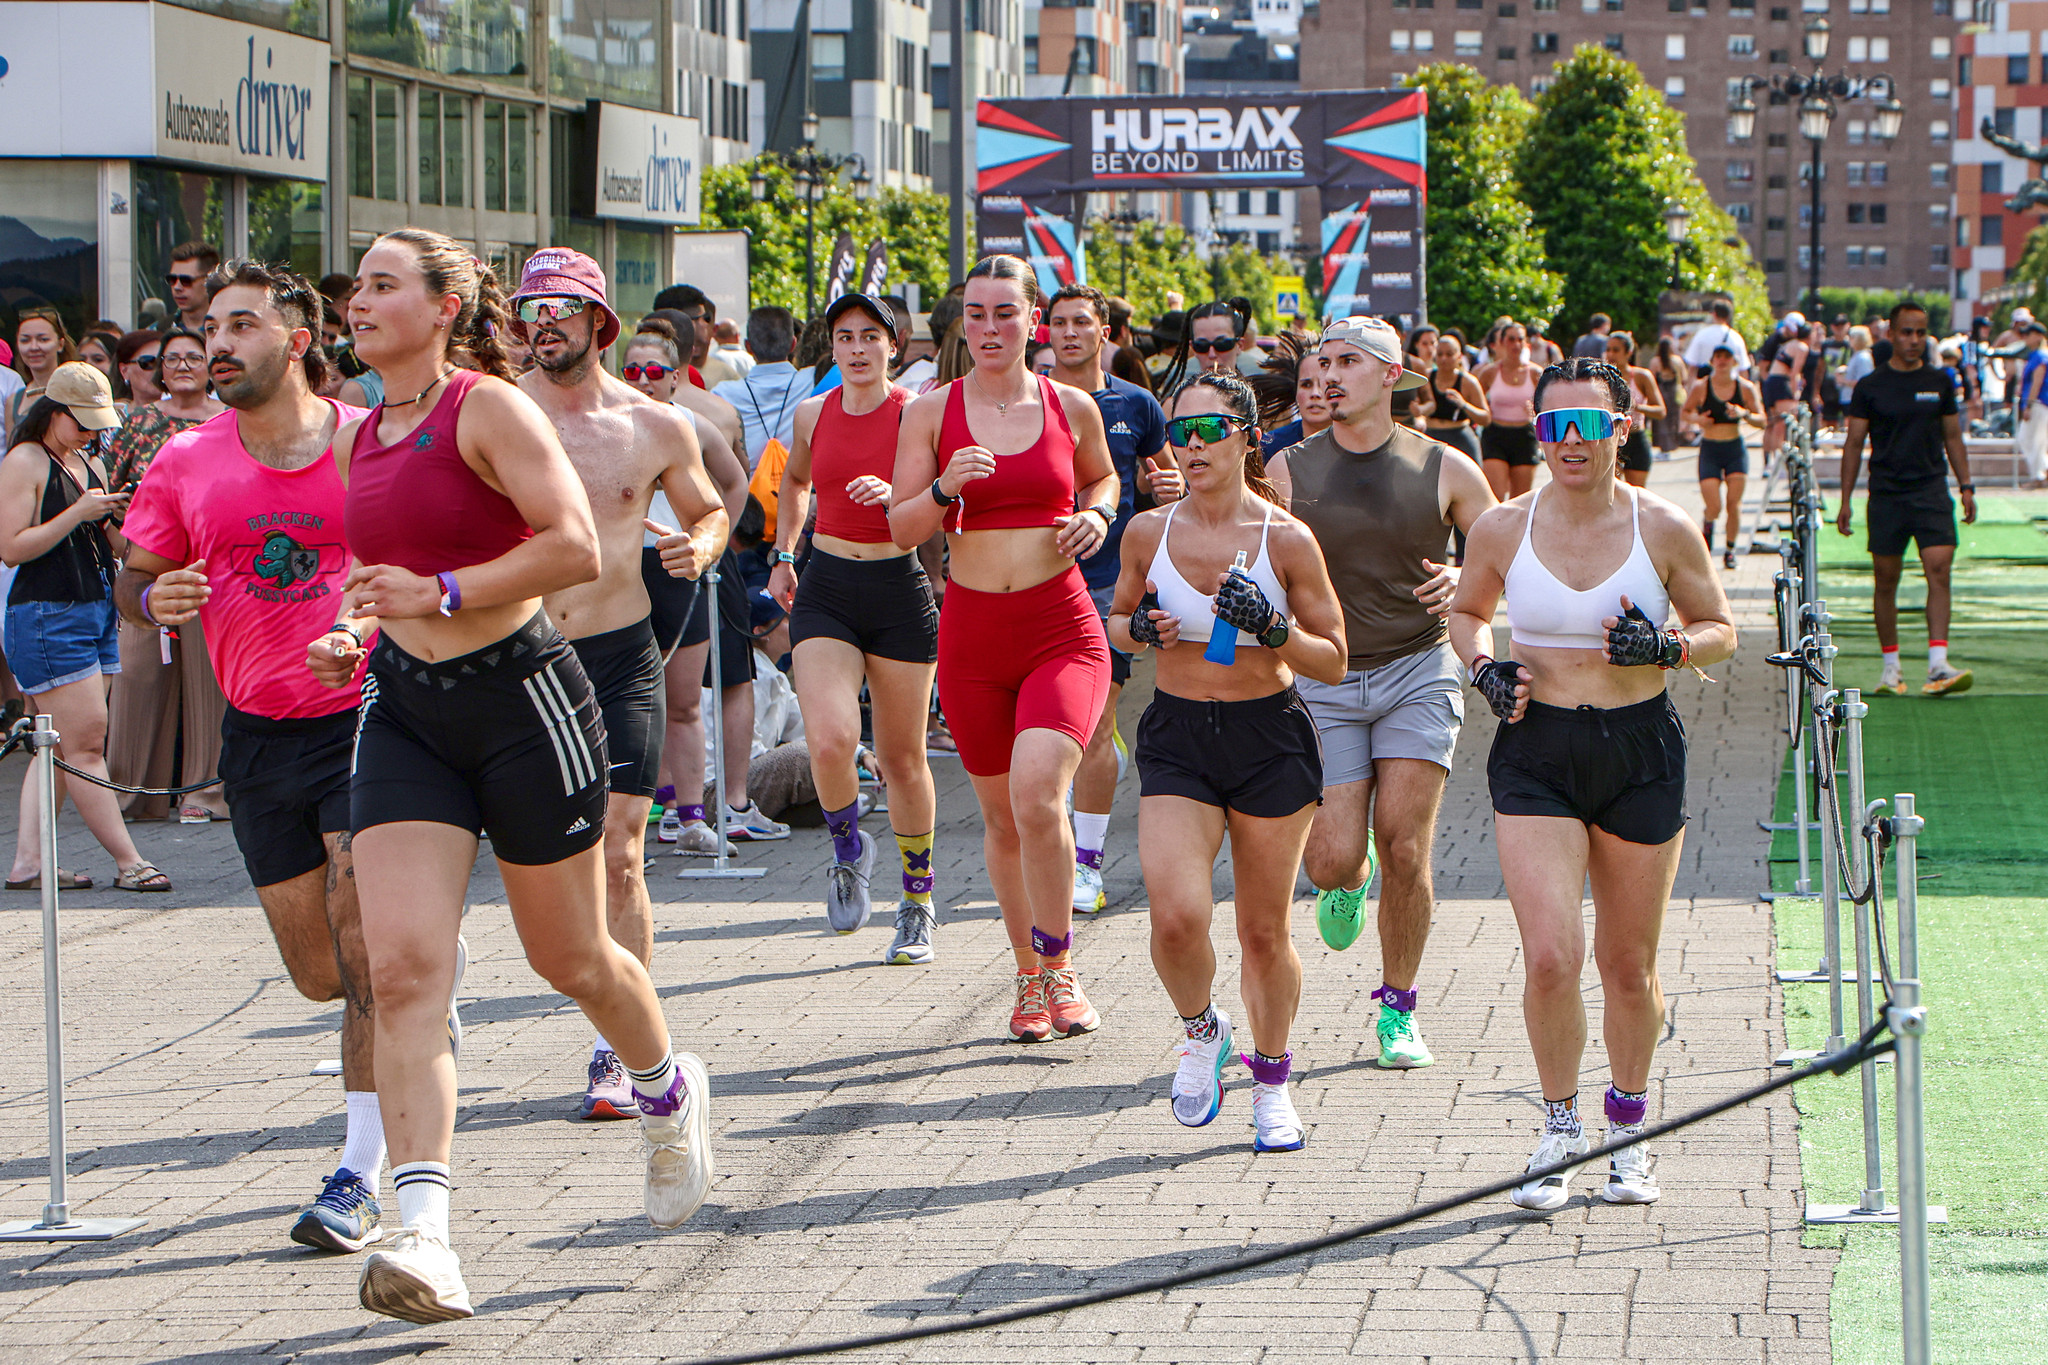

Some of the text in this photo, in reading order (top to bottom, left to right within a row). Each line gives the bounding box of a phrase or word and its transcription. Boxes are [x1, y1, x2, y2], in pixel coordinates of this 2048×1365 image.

[166, 34, 311, 161] Autoescuela driver
[1091, 106, 1304, 153] HURBAX
[602, 123, 691, 214] Autoescuela driver
[1092, 149, 1305, 173] BEYOND LIMITS
[246, 512, 325, 531] BRACKEN
[244, 582, 331, 603] PUSSYCATS
[565, 822, 591, 836] adidas
